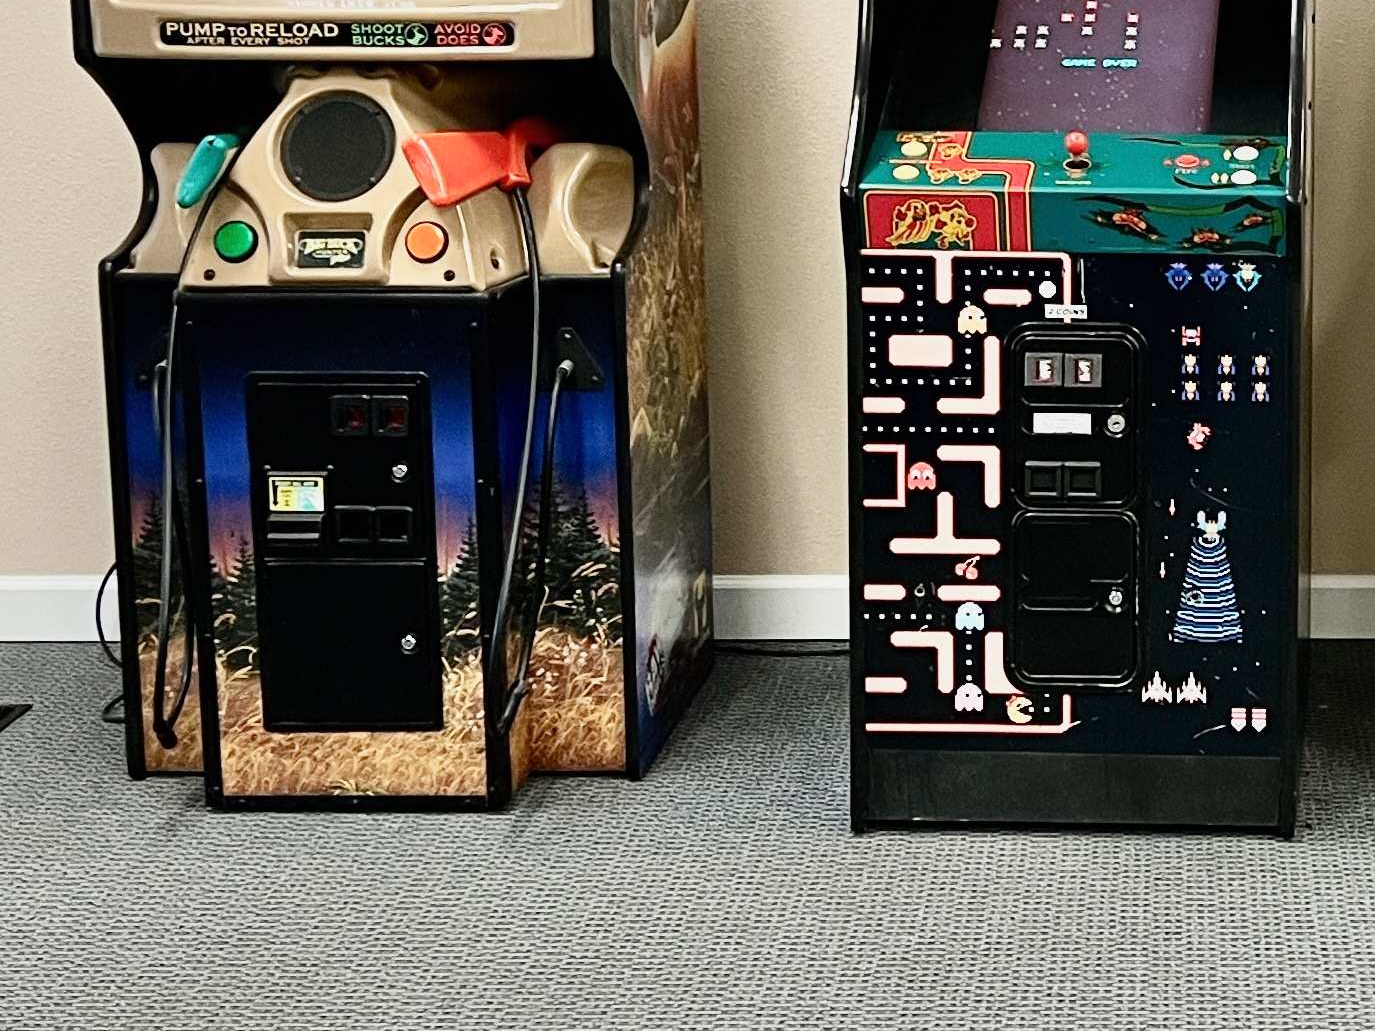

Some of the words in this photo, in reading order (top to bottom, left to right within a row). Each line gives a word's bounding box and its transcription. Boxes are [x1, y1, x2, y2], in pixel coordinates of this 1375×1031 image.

[165, 21, 226, 37] PUMP
[250, 22, 340, 37] RELOAD
[350, 23, 405, 34] SHOOT
[433, 23, 481, 34] AVOID
[185, 36, 226, 45] AFTER
[230, 36, 271, 46] EVERY
[276, 36, 311, 45] SHOT
[352, 35, 406, 46] BUCKS
[436, 35, 480, 45] DOES
[1061, 58, 1097, 67] GAME
[1102, 58, 1139, 68] OVER
